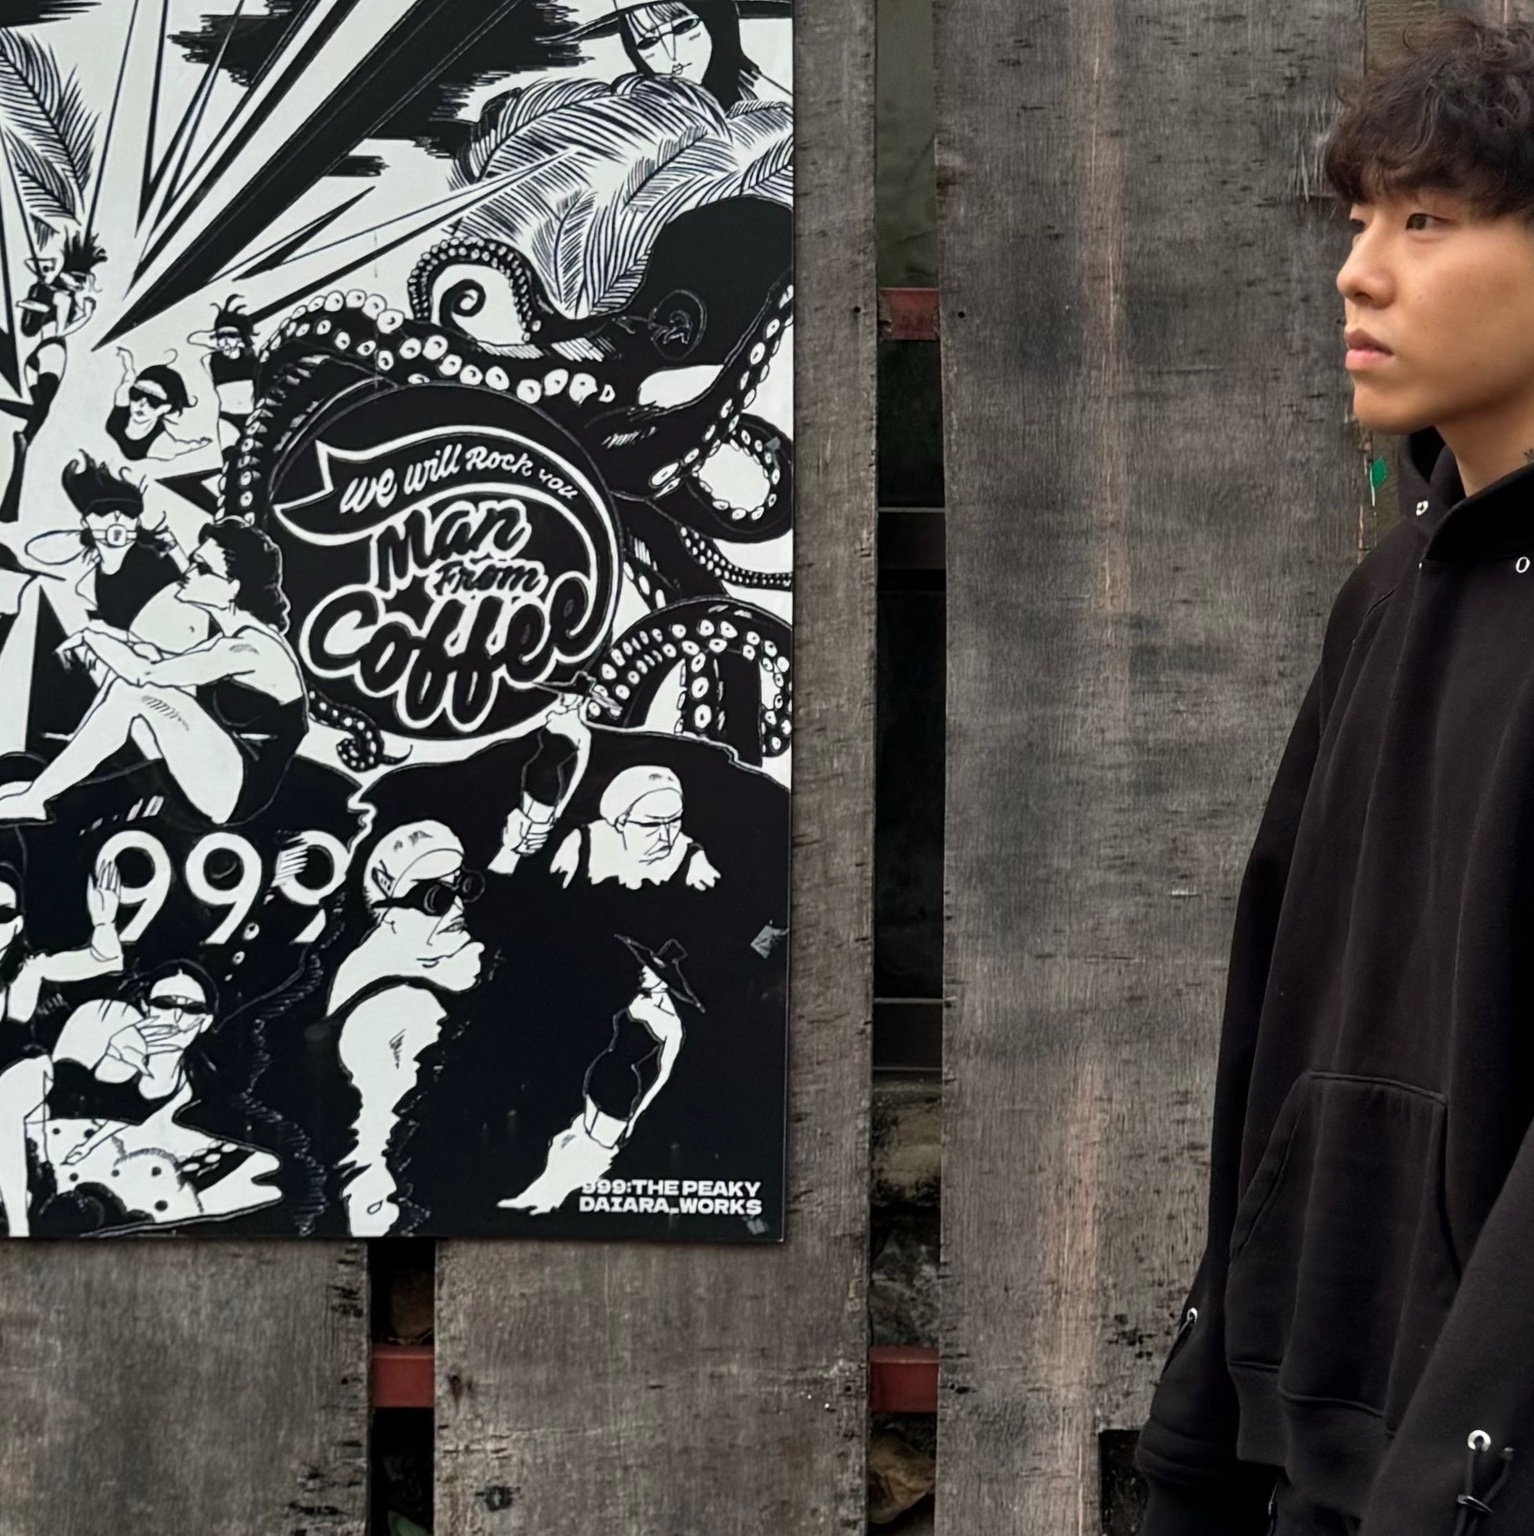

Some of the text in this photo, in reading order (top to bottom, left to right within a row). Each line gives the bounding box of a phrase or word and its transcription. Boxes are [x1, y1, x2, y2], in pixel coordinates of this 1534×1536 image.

[403, 443, 463, 495] will
[465, 446, 534, 476] Rock
[539, 467, 579, 499] you
[373, 501, 530, 596] Man
[430, 558, 543, 597] From
[302, 572, 600, 730] Coffee
[682, 1180, 762, 1197] PEAKY
